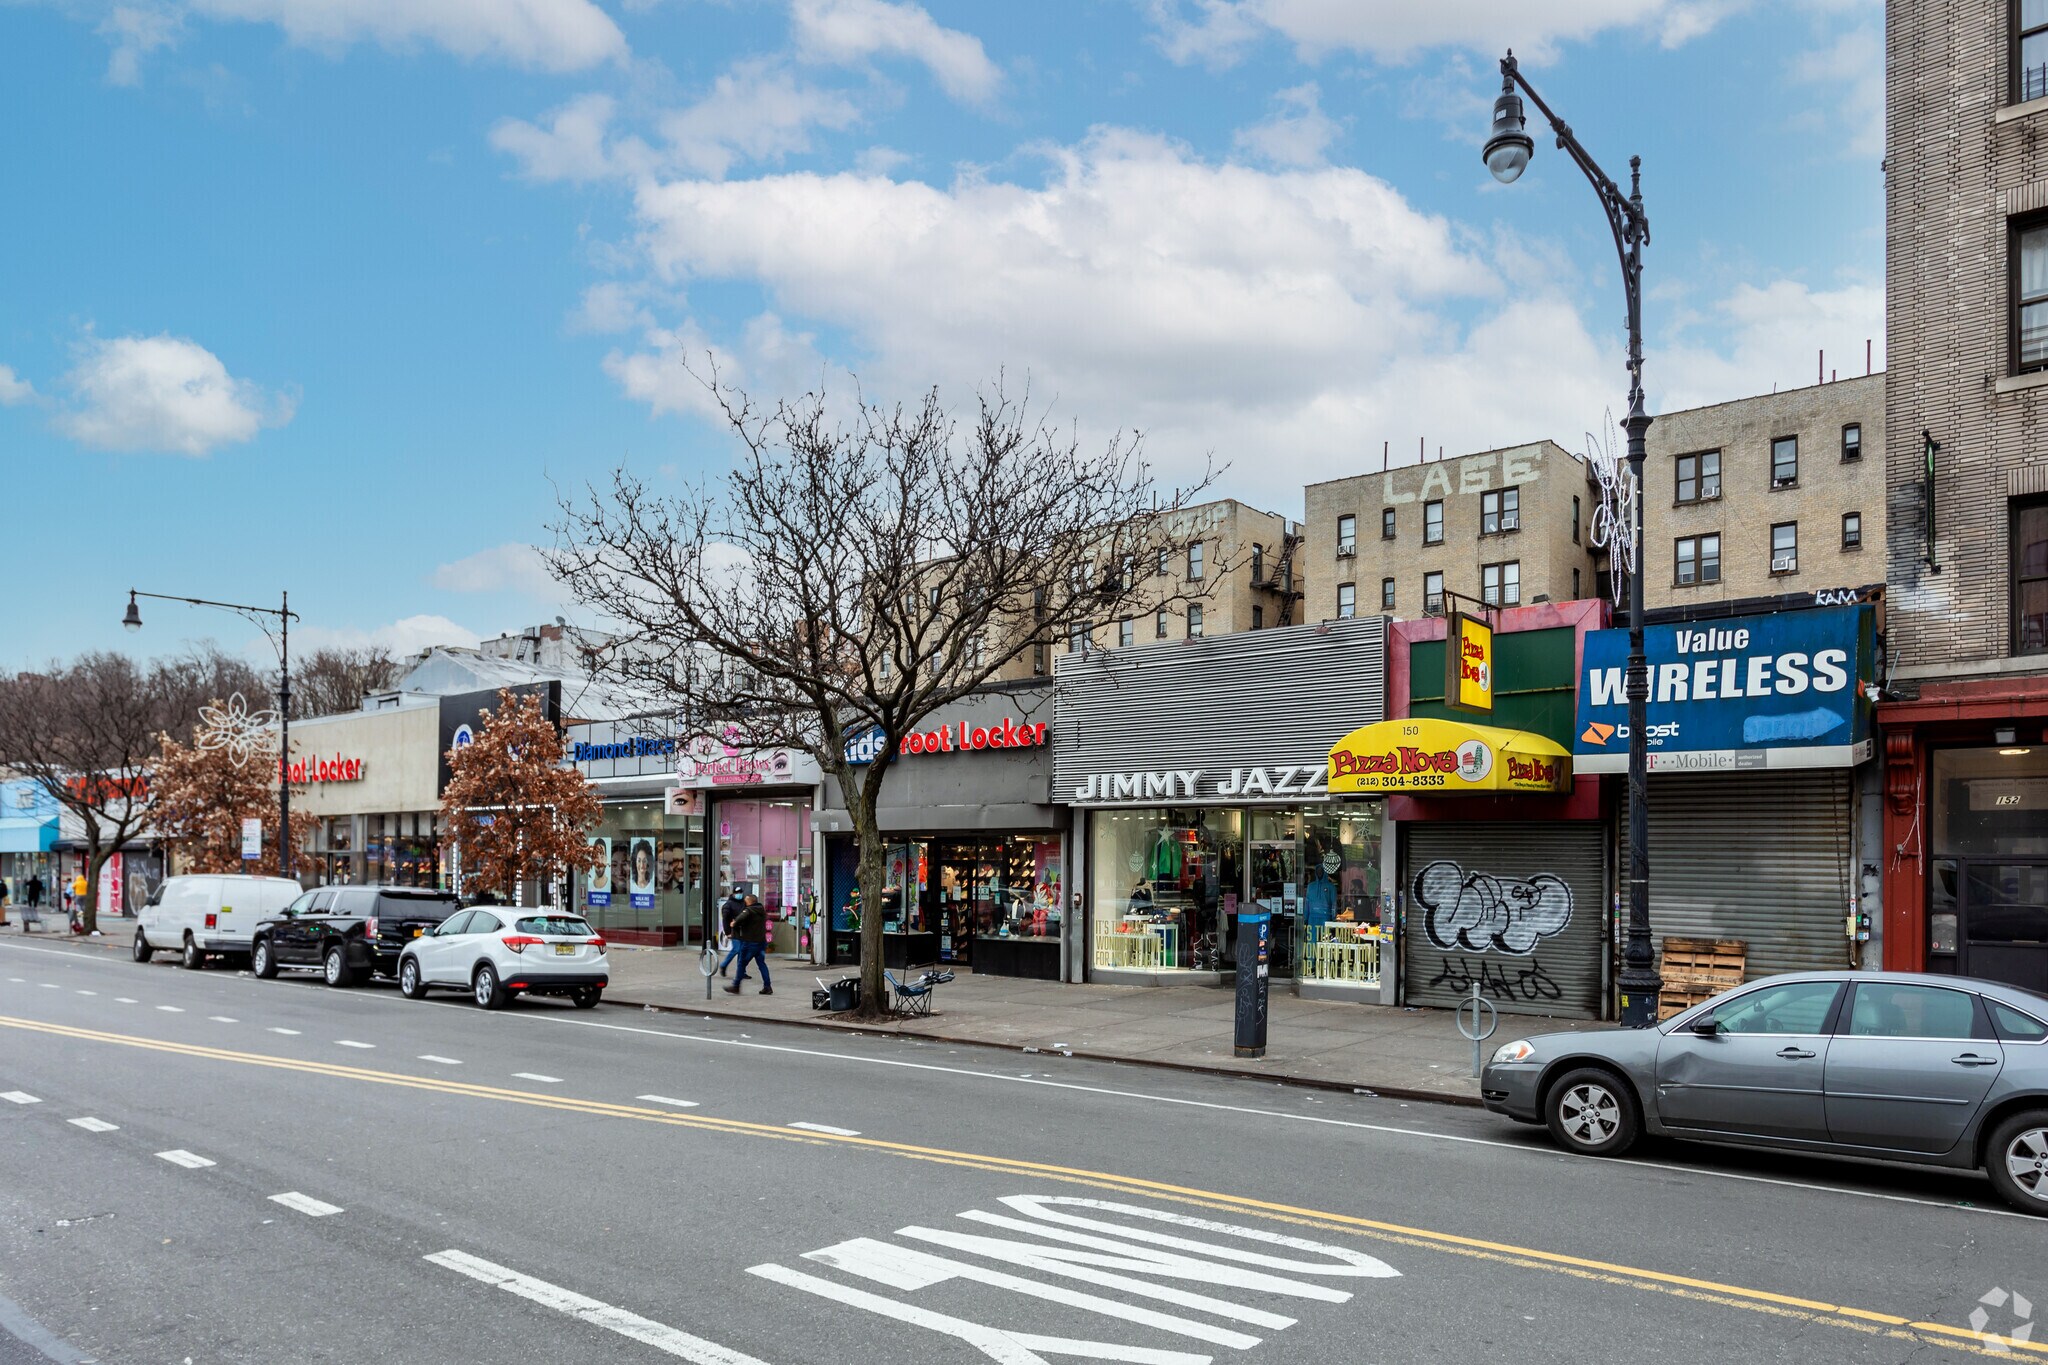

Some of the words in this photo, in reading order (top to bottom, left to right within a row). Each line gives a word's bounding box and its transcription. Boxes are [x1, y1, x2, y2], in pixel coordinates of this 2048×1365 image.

[1462, 636, 1484, 660] Pizza
[1676, 628, 1750, 654] Value
[1461, 658, 1481, 683] Nova
[959, 718, 1047, 751] Locker
[1403, 726, 1419, 736] 150
[1616, 721, 1680, 739] bost
[574, 738, 634, 761] Diamond
[636, 737, 675, 757] Brace
[843, 731, 887, 762] ids
[312, 752, 361, 782] Locker
[695, 759, 731, 776] Perfect
[1330, 749, 1400, 778] Pizza
[1397, 747, 1460, 775] Nova
[1507, 757, 1533, 782] Pizza
[1676, 753, 1727, 769] Mobile
[1076, 770, 1205, 799] JIMMY
[1218, 767, 1328, 795] JAZZ
[1357, 777, 1379, 787] (212)
[1997, 796, 2020, 805] 152
